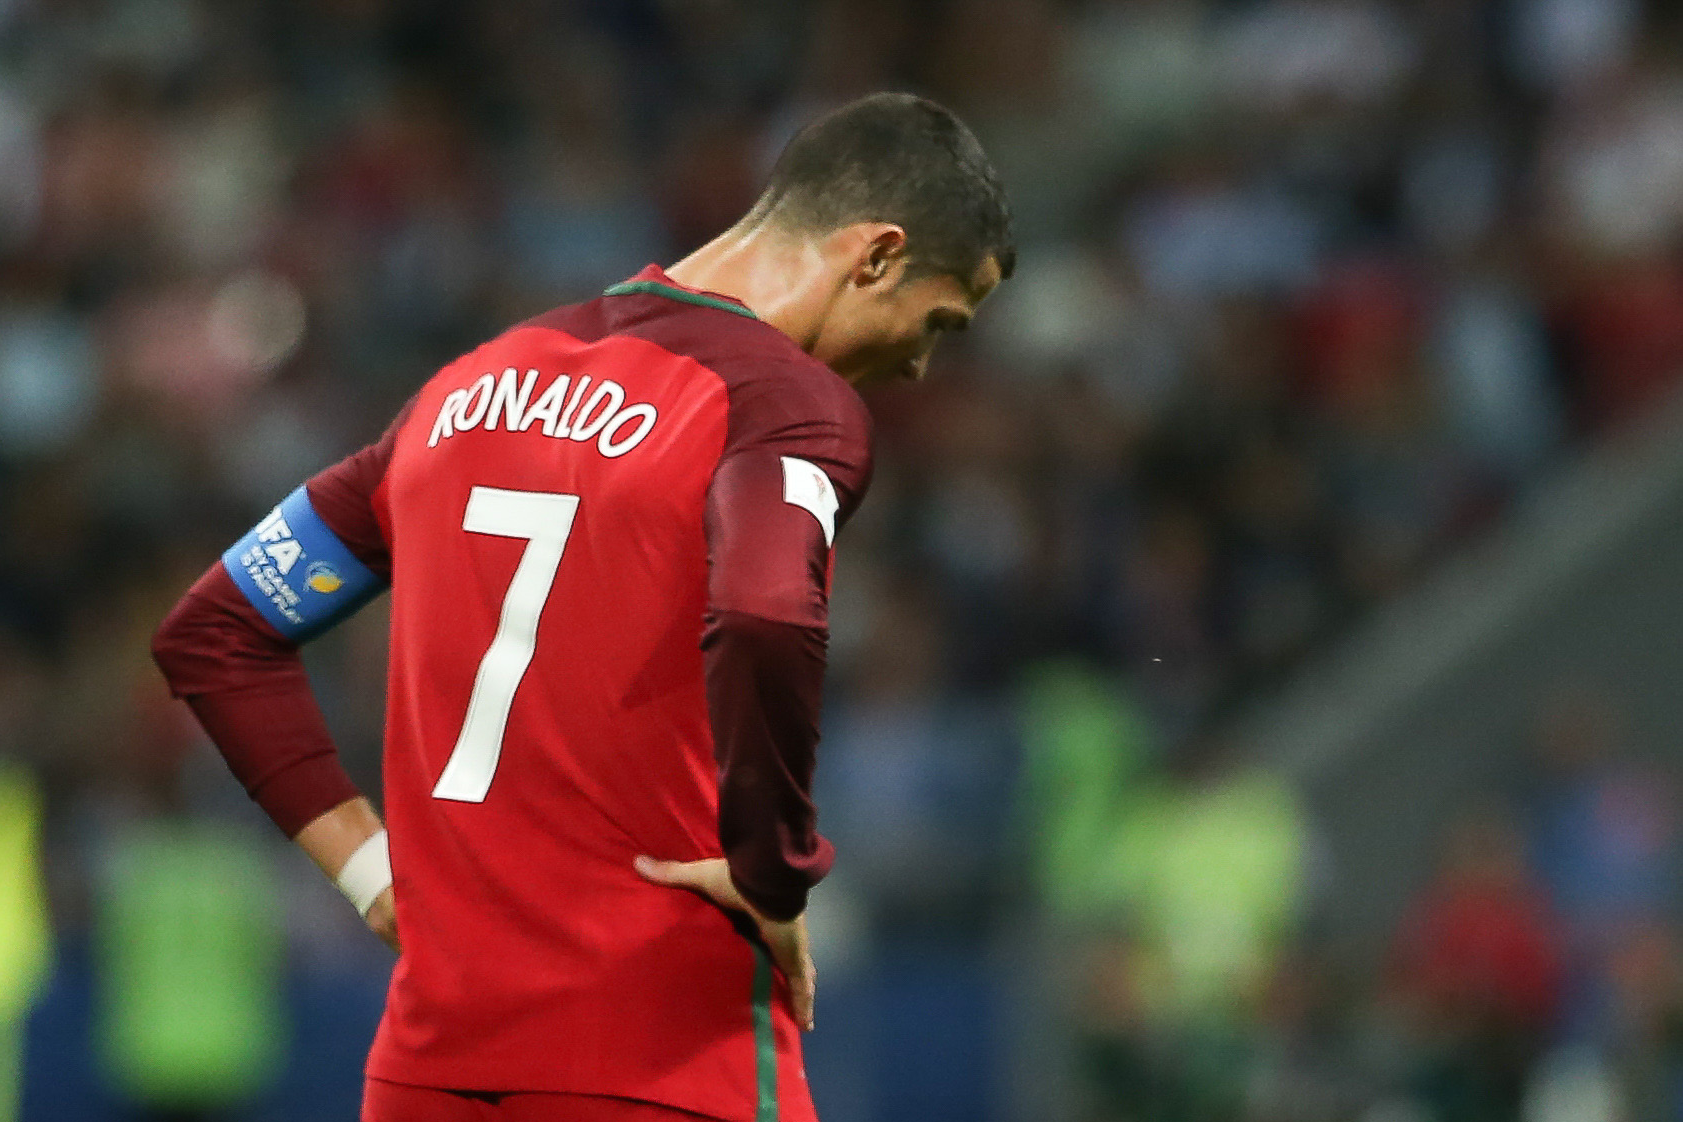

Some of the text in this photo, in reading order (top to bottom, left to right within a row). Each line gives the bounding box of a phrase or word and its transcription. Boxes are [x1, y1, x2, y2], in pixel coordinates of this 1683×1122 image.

[427, 367, 658, 458] RONALDO
[253, 505, 304, 575] IFA
[431, 486, 580, 803] 7
